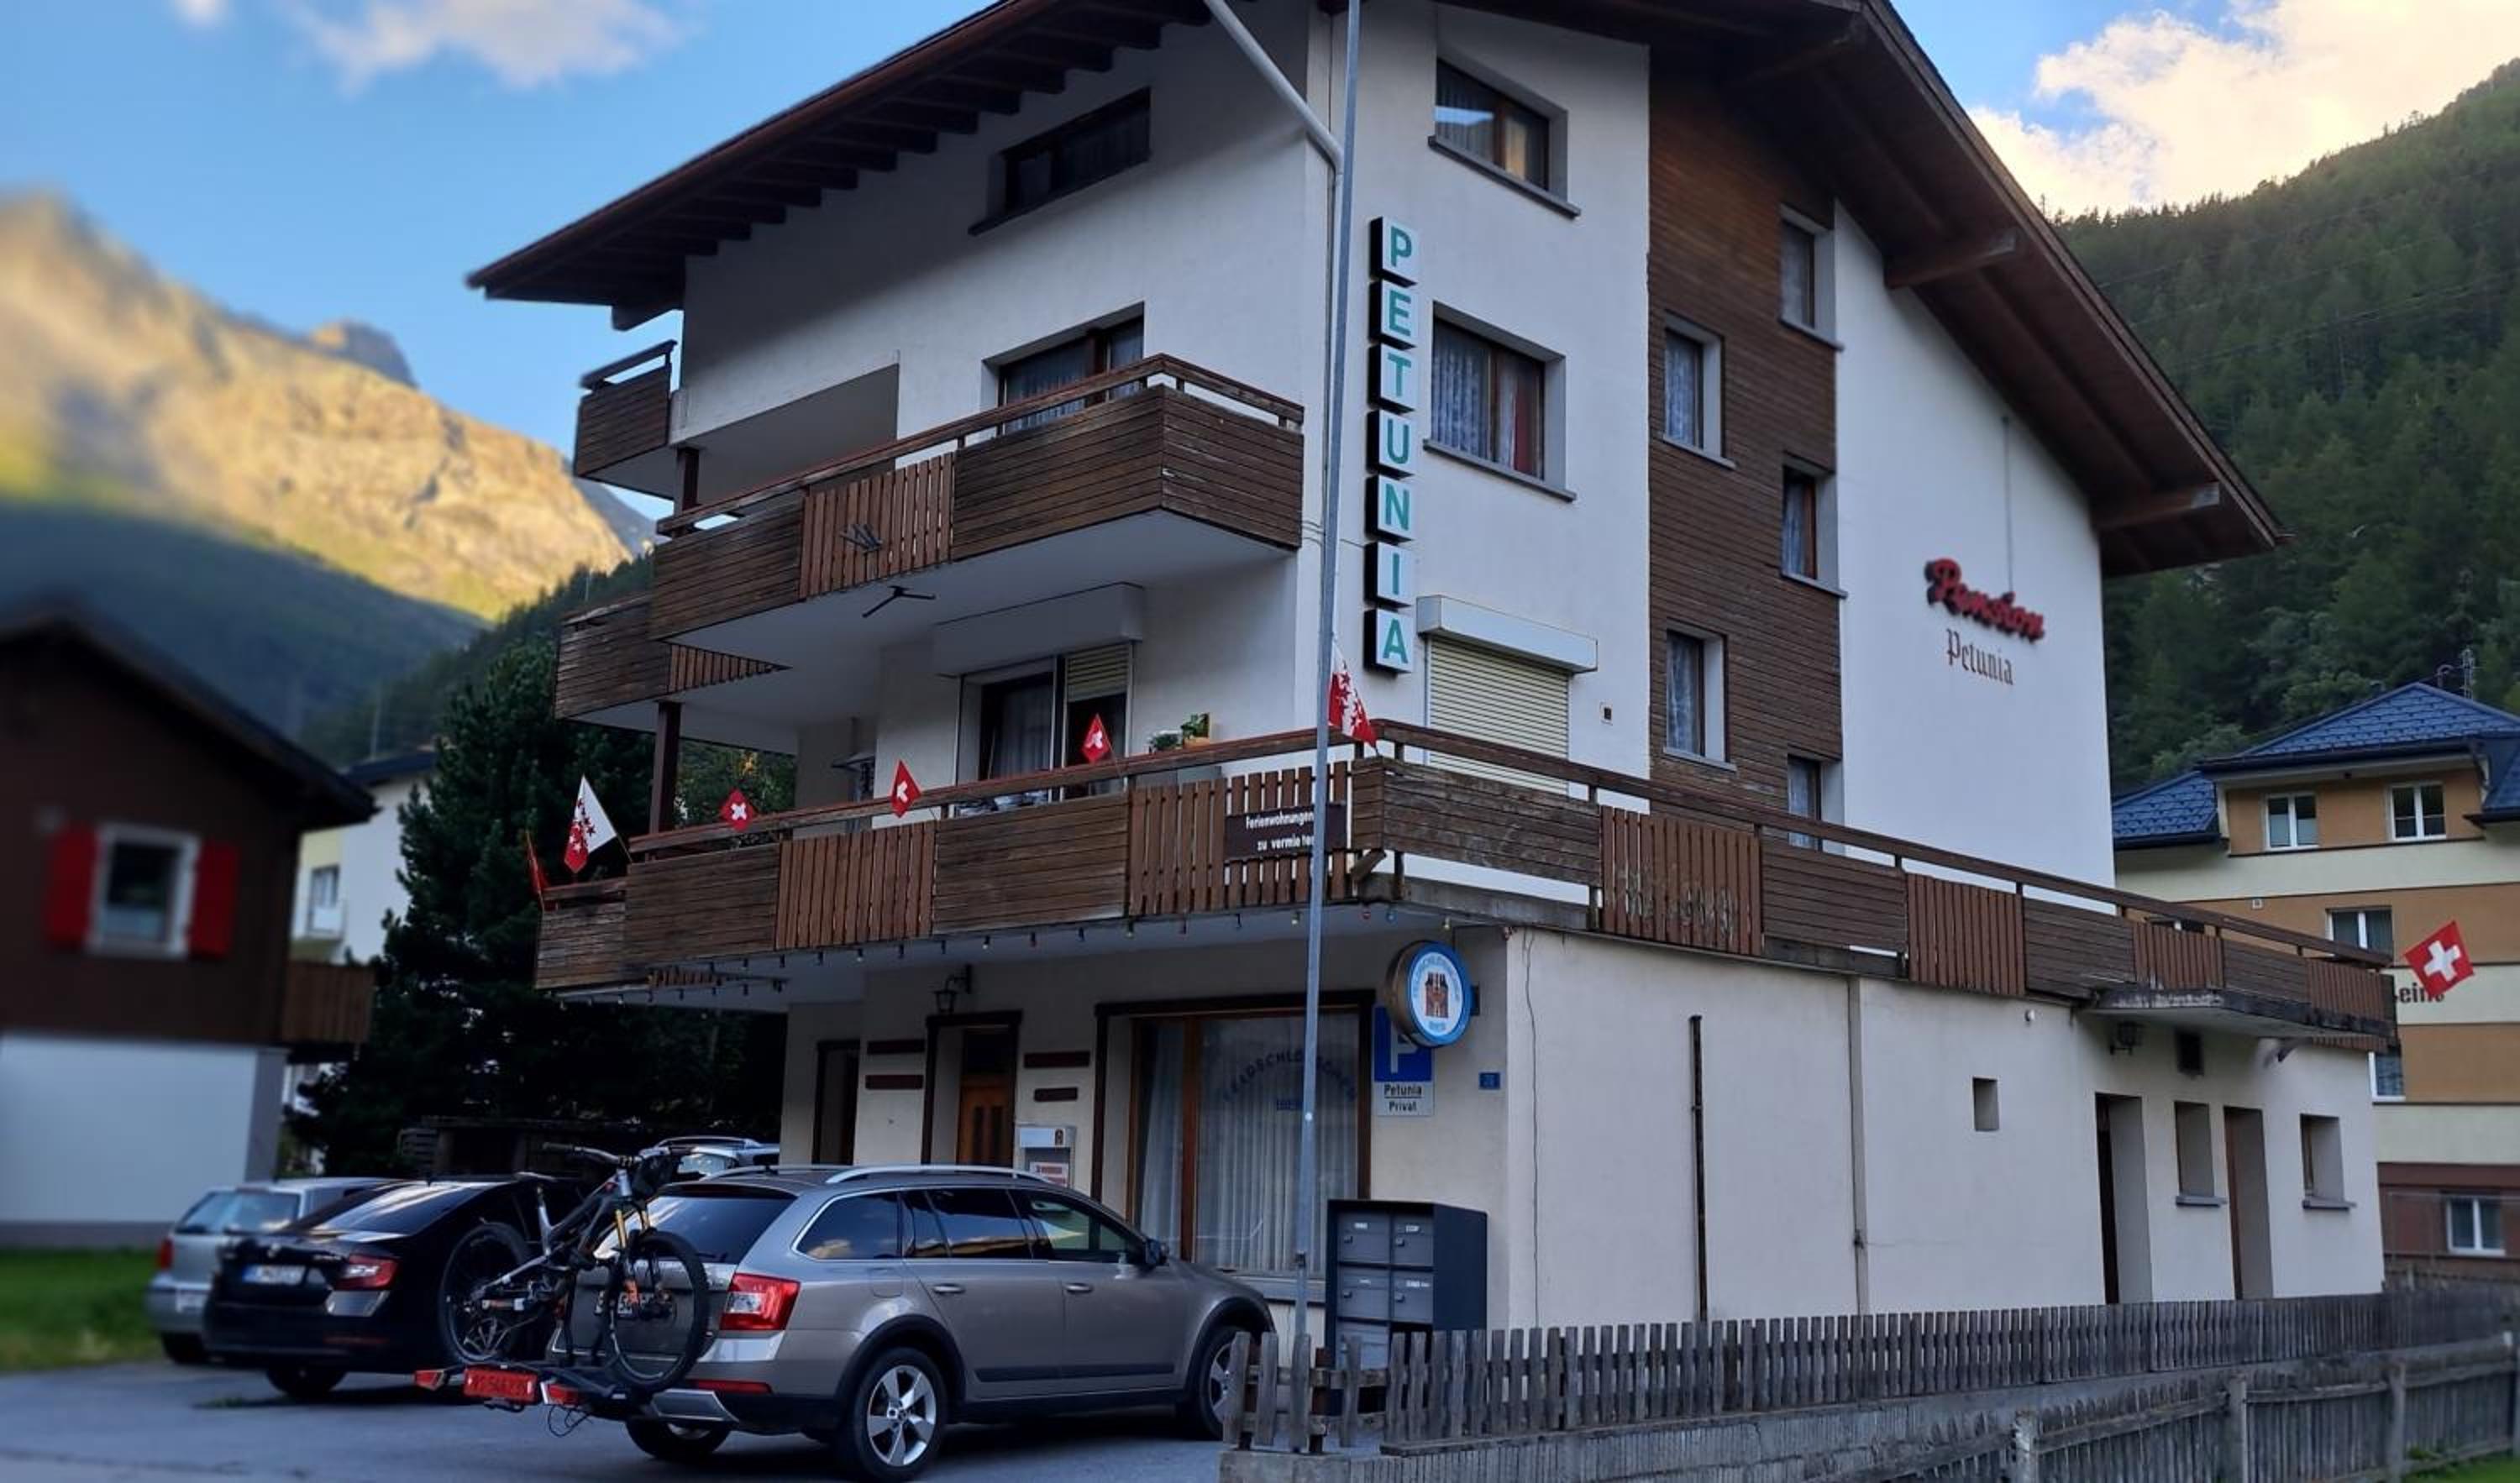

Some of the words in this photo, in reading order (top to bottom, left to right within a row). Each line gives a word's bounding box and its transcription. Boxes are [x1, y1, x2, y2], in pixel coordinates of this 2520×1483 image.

[1382, 226, 1413, 665] PETUNIA
[1945, 627, 2013, 686] Petunia
[1257, 841, 1268, 852] zu
[1383, 1084, 1422, 1097] Petunia
